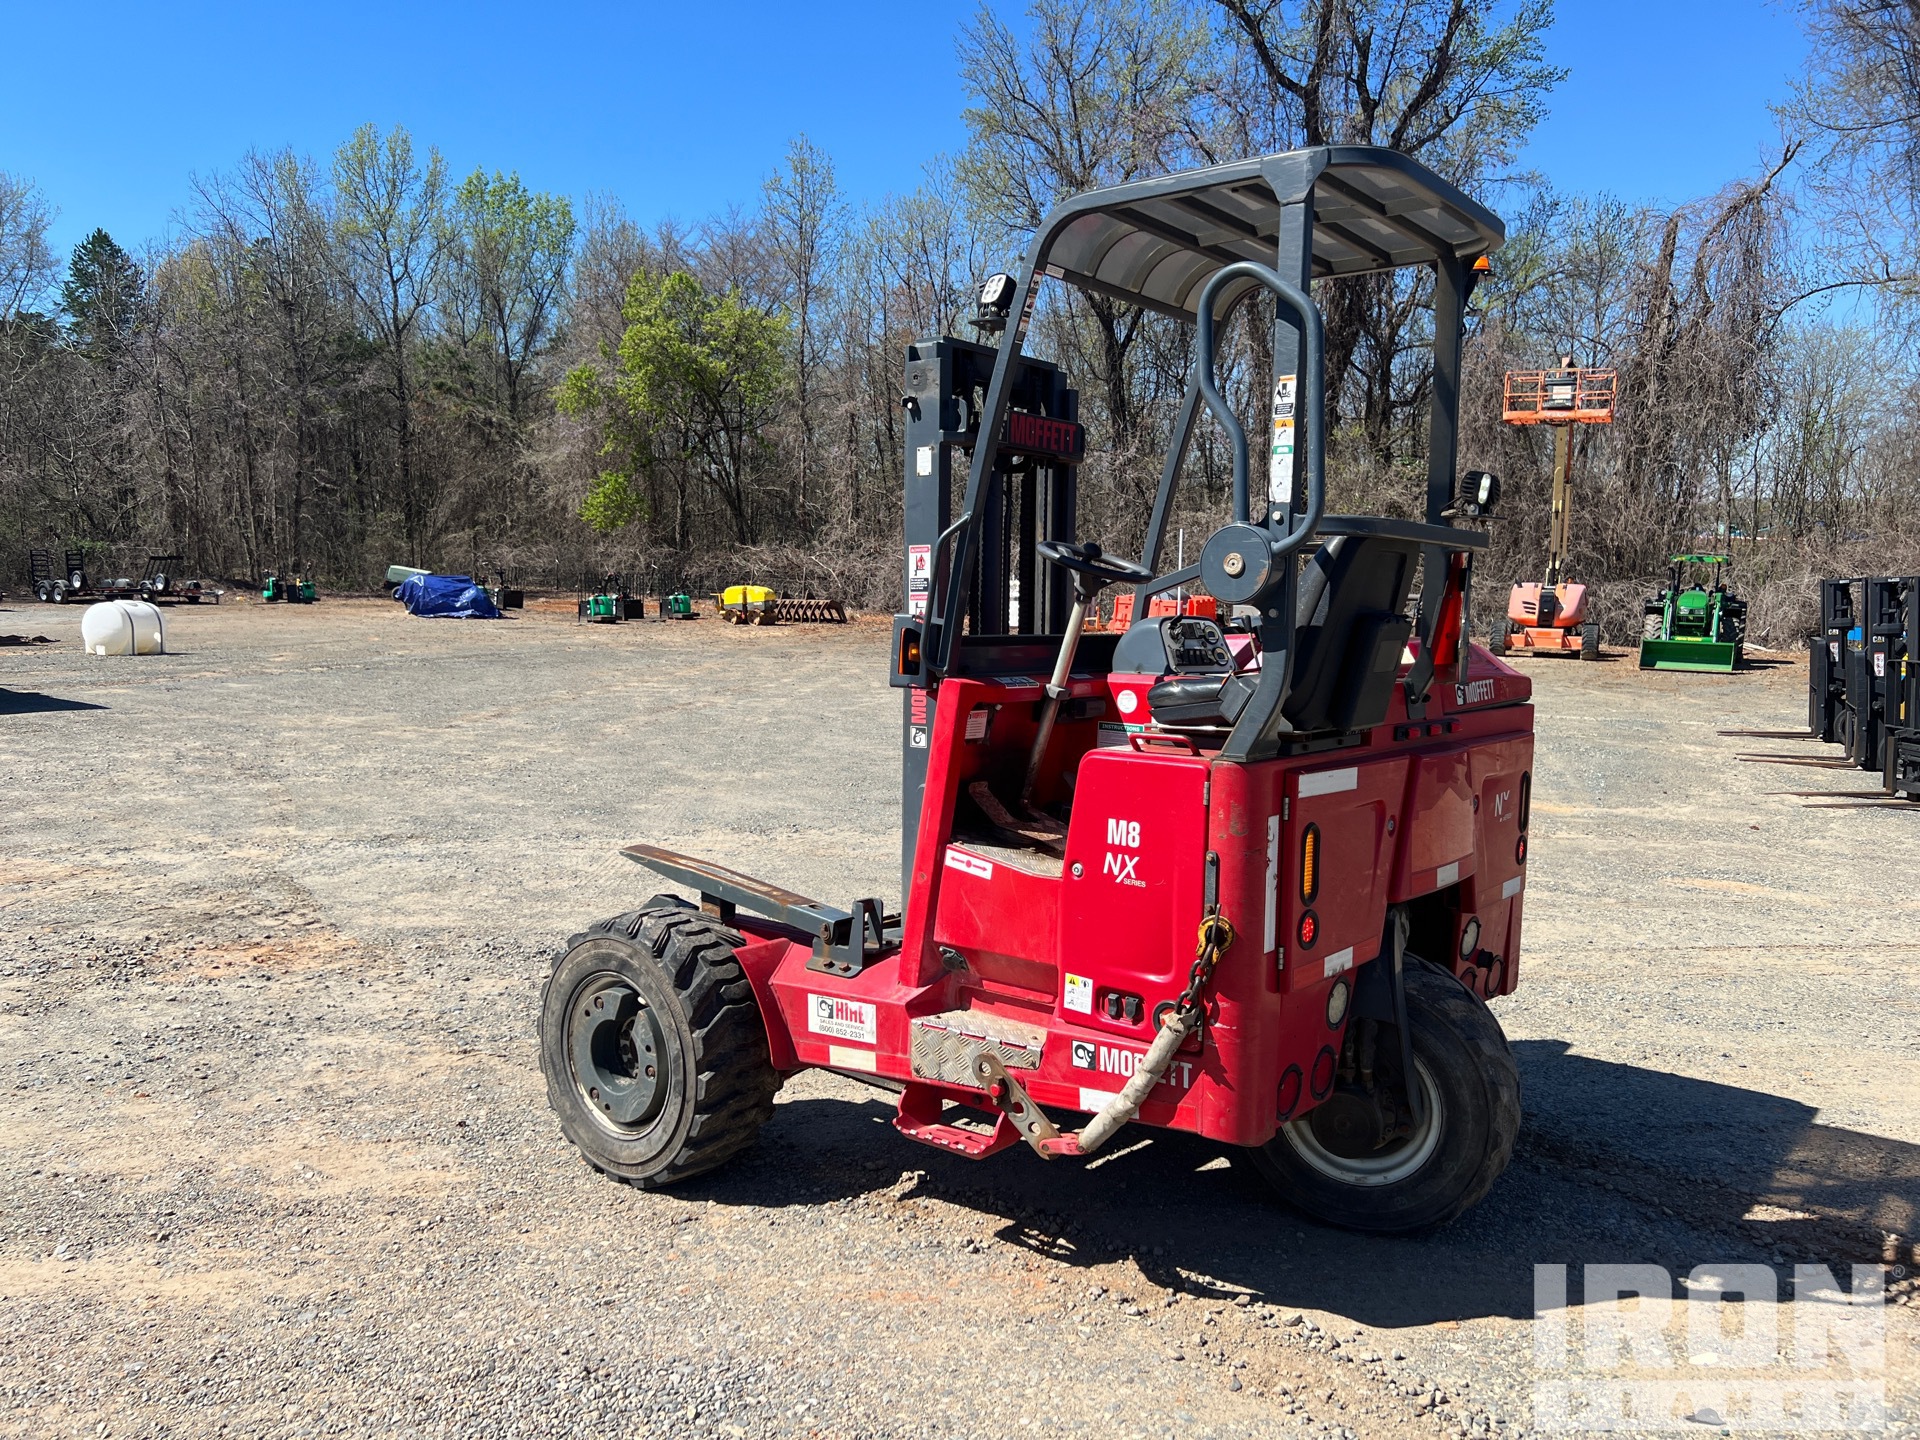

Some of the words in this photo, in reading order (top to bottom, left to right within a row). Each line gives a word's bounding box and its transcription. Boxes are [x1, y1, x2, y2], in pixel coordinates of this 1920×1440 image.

[1010, 413, 1077, 453] MOFFETT
[1465, 679, 1494, 703] MOFFETT
[1102, 723, 1140, 732] INSTRUCTIONS
[1107, 818, 1141, 848] M8
[1103, 852, 1140, 883] NX
[1123, 878, 1146, 888] SERIES
[819, 1024, 834, 1034] (800)
[836, 1028, 865, 1040] 852-2331
